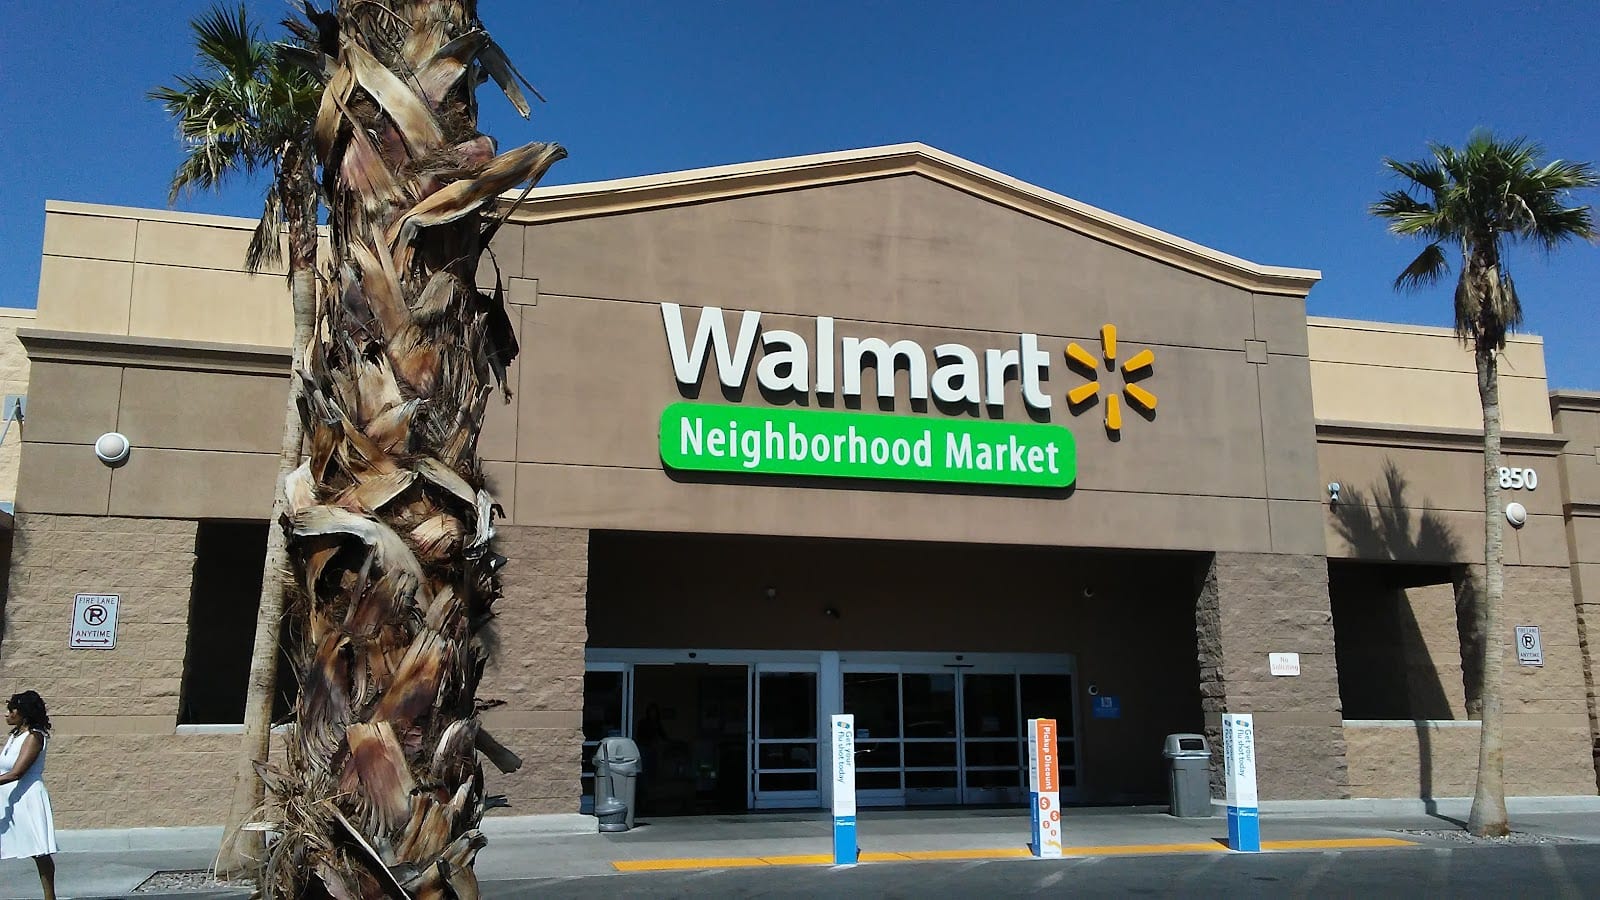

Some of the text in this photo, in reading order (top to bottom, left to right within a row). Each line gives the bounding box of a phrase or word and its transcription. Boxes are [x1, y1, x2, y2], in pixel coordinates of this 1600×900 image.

[661, 302, 1051, 408] Walmart
[680, 416, 1059, 474] Neighborhood Market
[1499, 467, 1537, 489] 850
[1042, 726, 1051, 753] Pickup
[837, 761, 846, 783] today
[1044, 755, 1052, 790] Discount
